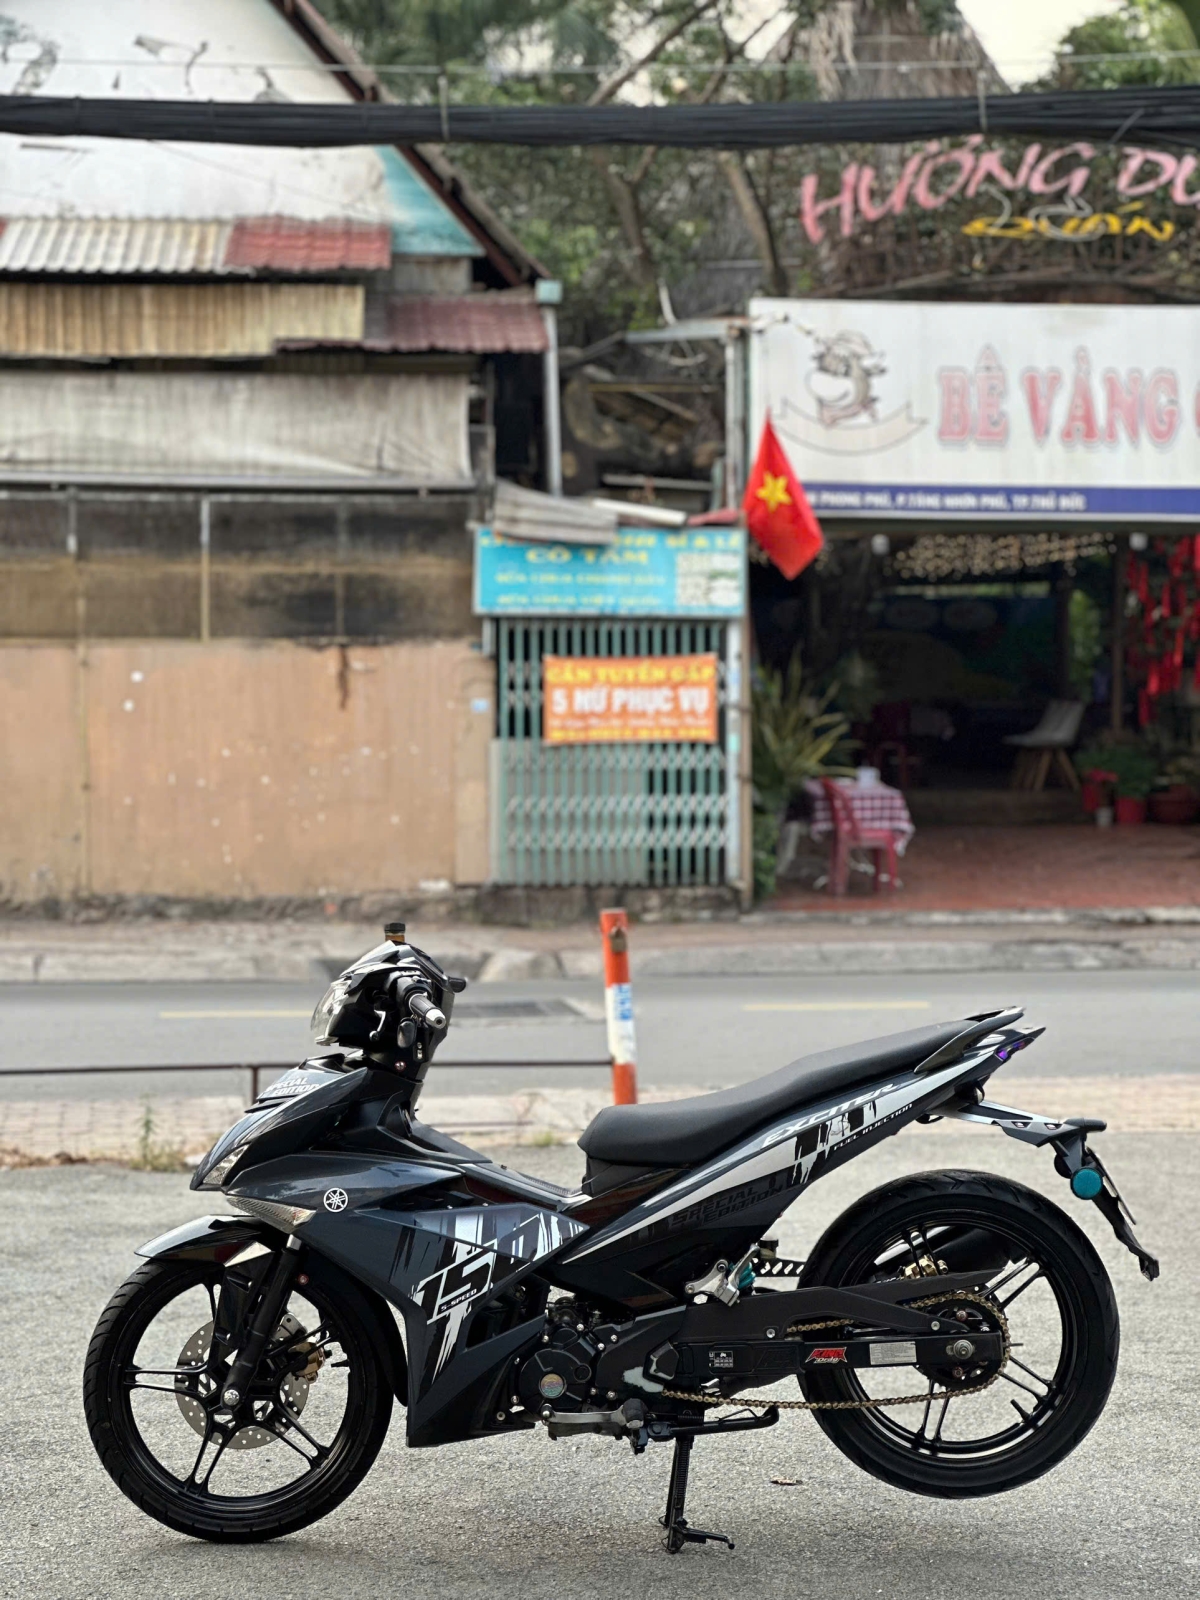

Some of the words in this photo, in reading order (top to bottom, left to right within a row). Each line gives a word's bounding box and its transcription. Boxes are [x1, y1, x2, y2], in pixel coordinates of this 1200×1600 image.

[761, 1083, 895, 1148] EXCITER
[834, 1134, 860, 1151] FUEL
[862, 1103, 913, 1135] INJECTION
